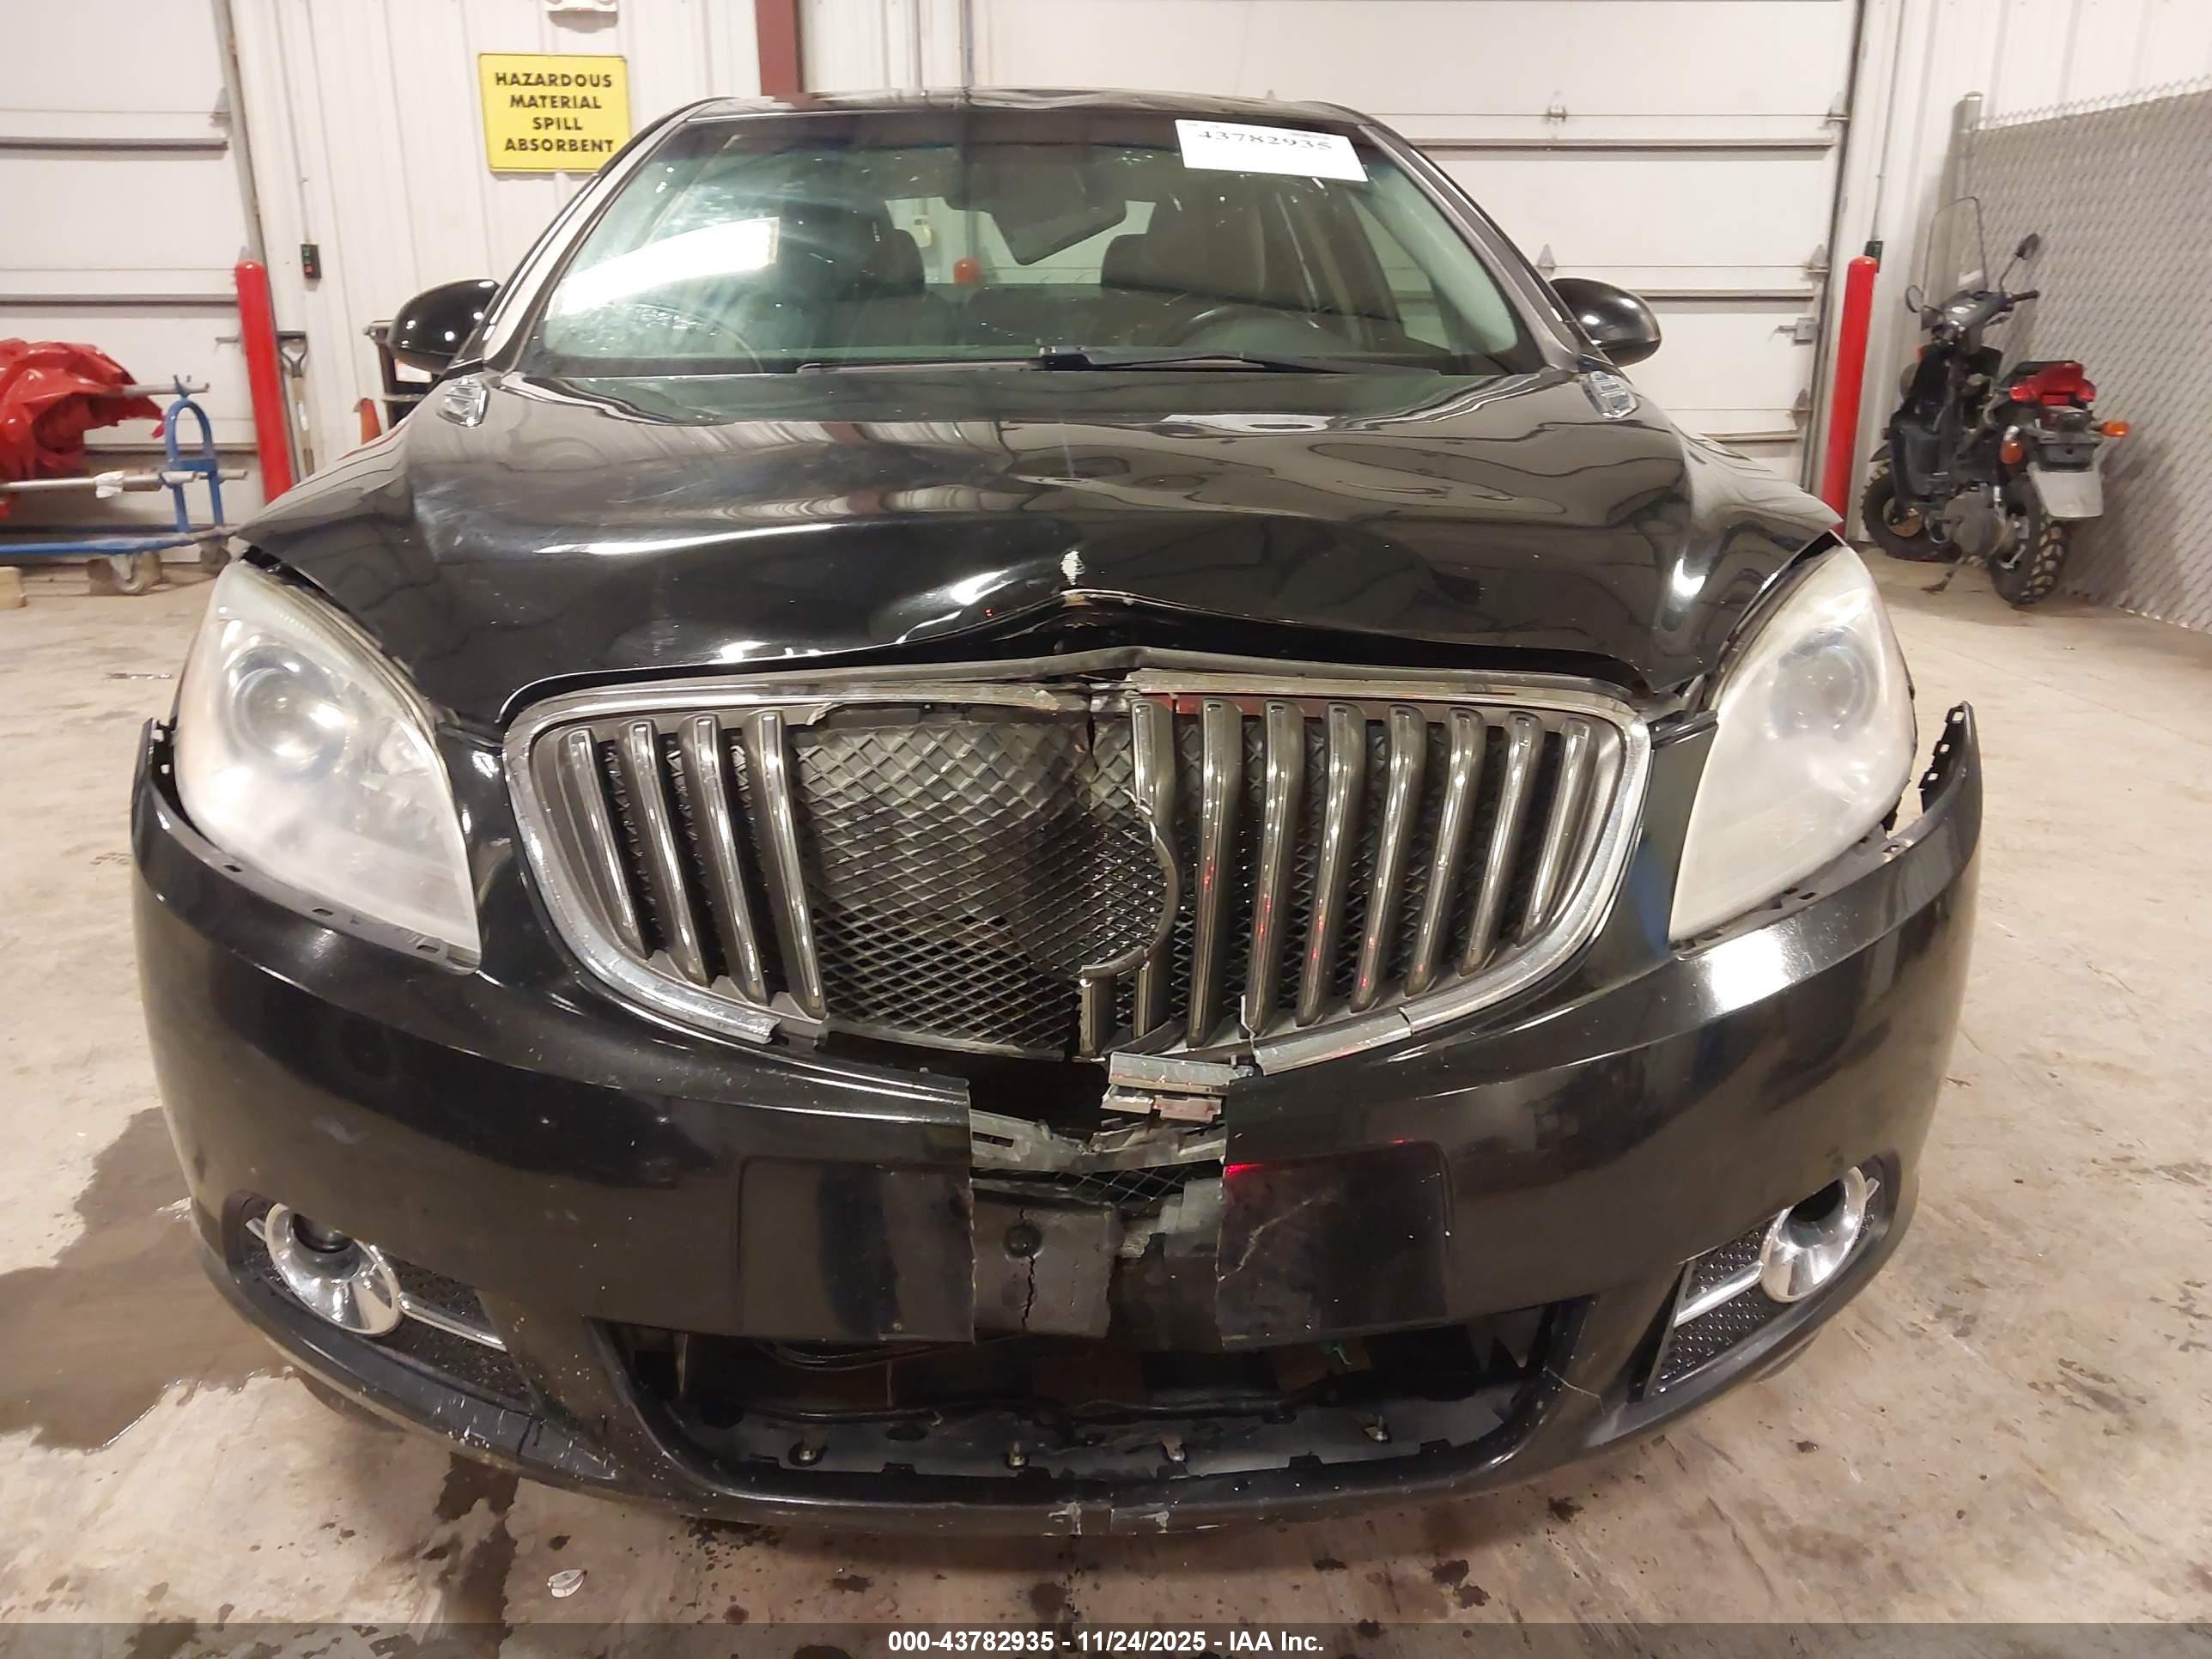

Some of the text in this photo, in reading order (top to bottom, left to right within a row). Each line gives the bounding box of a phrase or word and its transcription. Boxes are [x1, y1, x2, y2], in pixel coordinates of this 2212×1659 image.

[495, 72, 612, 88] HAZARDOUS
[509, 94, 602, 109] MATERIAL
[532, 117, 583, 131] SPILL
[504, 138, 614, 153] ABSORBENT
[1198, 130, 1332, 150] 43782935
